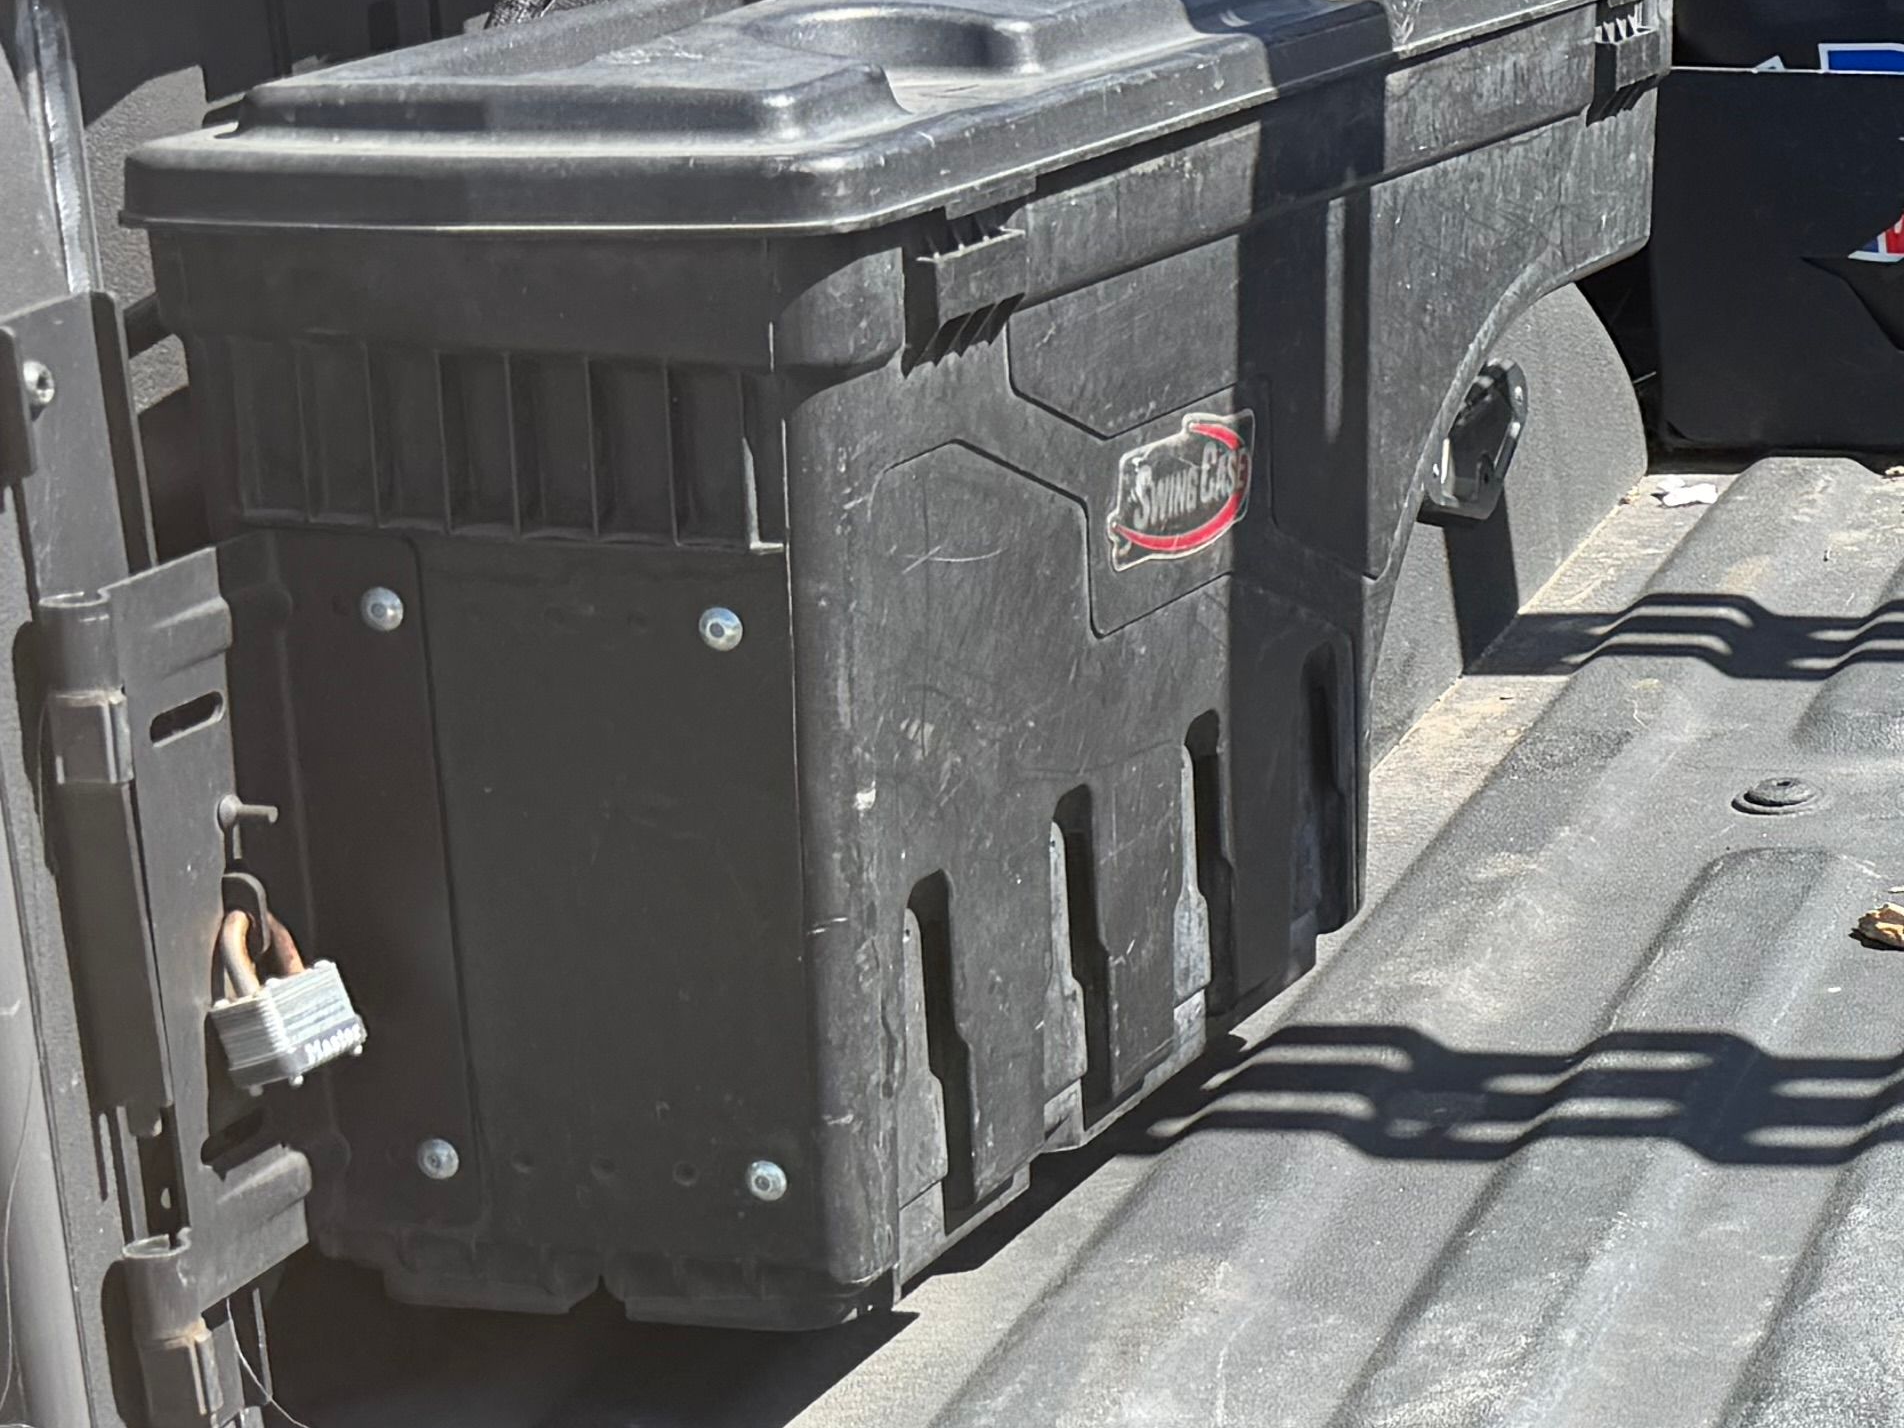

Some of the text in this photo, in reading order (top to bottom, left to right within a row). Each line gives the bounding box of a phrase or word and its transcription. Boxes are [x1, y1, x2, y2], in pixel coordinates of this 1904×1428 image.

[1133, 441, 1249, 529] SWING CASE
[304, 1024, 361, 1064] Master
